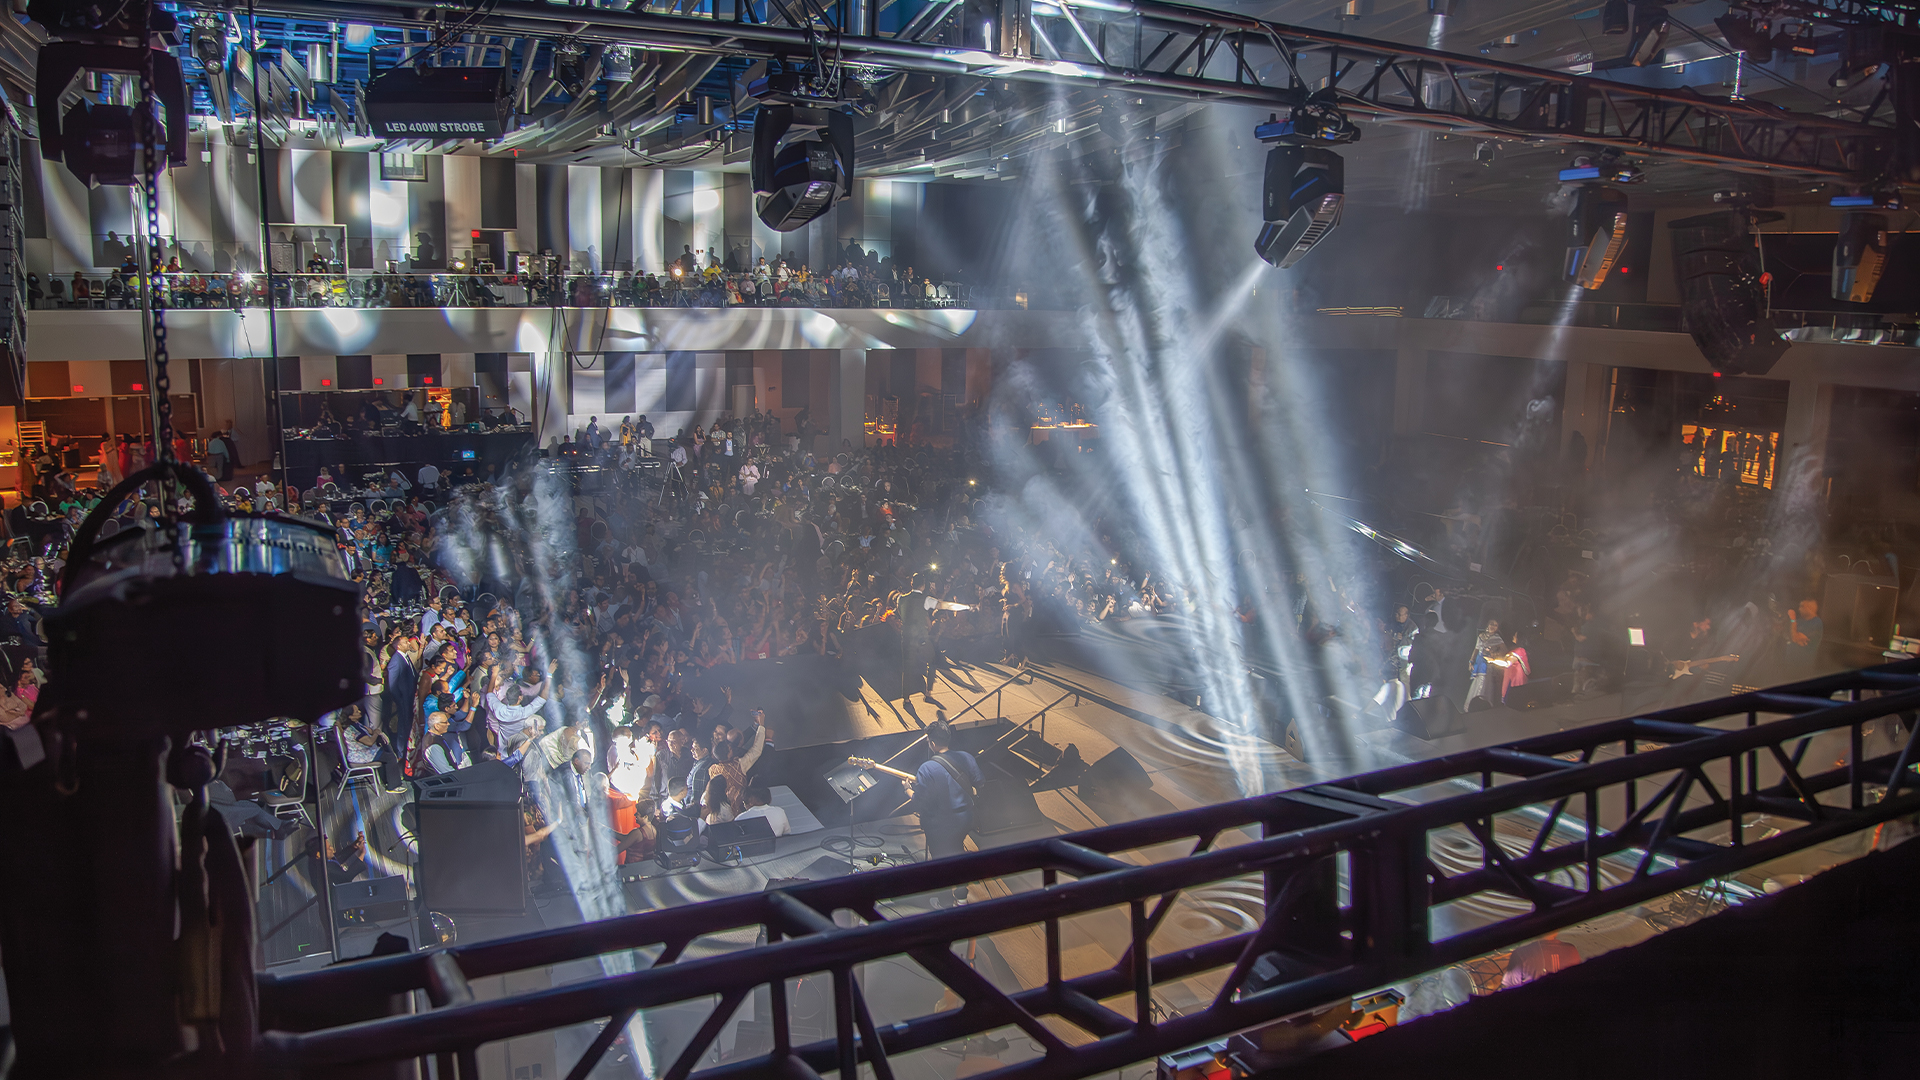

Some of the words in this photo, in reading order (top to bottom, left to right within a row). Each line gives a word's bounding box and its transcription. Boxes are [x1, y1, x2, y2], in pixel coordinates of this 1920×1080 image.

[385, 122, 407, 132] LED
[409, 122, 438, 132] 400W
[440, 122, 485, 132] STROBE
